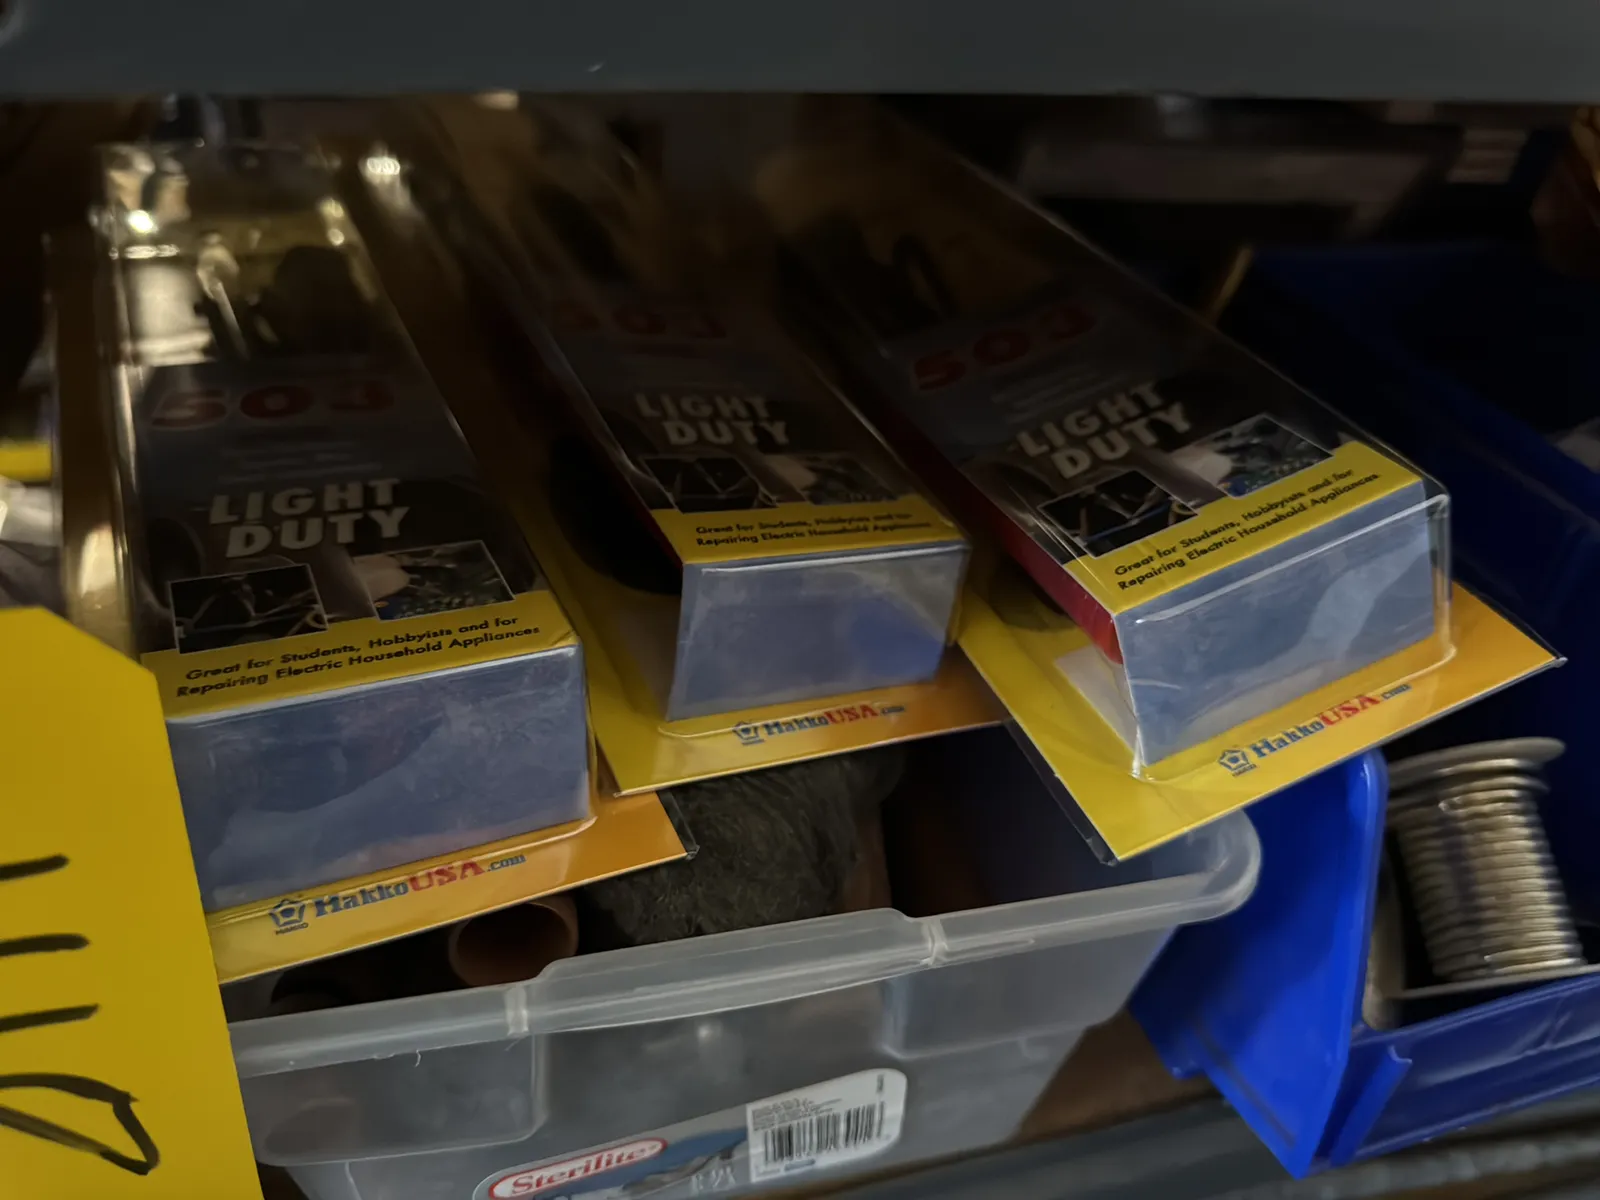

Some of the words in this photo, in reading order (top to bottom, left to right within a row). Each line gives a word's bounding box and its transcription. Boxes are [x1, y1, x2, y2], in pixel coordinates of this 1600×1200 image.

[634, 392, 772, 420] LIGHT
[661, 419, 790, 447] DUTY
[1015, 379, 1165, 459] LIGHT
[1051, 401, 1193, 480] DUTY
[209, 477, 400, 525] LIGHT
[1114, 555, 1155, 576] Great
[1156, 545, 1178, 560] for
[1179, 521, 1242, 549] Students,
[1307, 478, 1334, 493] and
[1332, 469, 1354, 481] for
[226, 506, 412, 559] DUTY
[696, 535, 760, 547] Repairing
[1117, 558, 1186, 591] Repairing
[1186, 535, 1238, 560] Electric
[1236, 503, 1308, 539] Household
[176, 674, 269, 698] Repairing
[276, 660, 343, 680] Electric
[348, 641, 443, 666] Household
[448, 626, 541, 649] Appliances
[185, 663, 241, 681] Great
[247, 658, 275, 670] for
[280, 644, 361, 664] Students,
[369, 628, 453, 649] Hobbyists
[458, 619, 489, 634] and
[494, 616, 519, 628] for
[763, 703, 906, 737] HakkoUSA.
[313, 853, 528, 918] HakkoUSA.com
[511, 1147, 648, 1197] Sterilite
